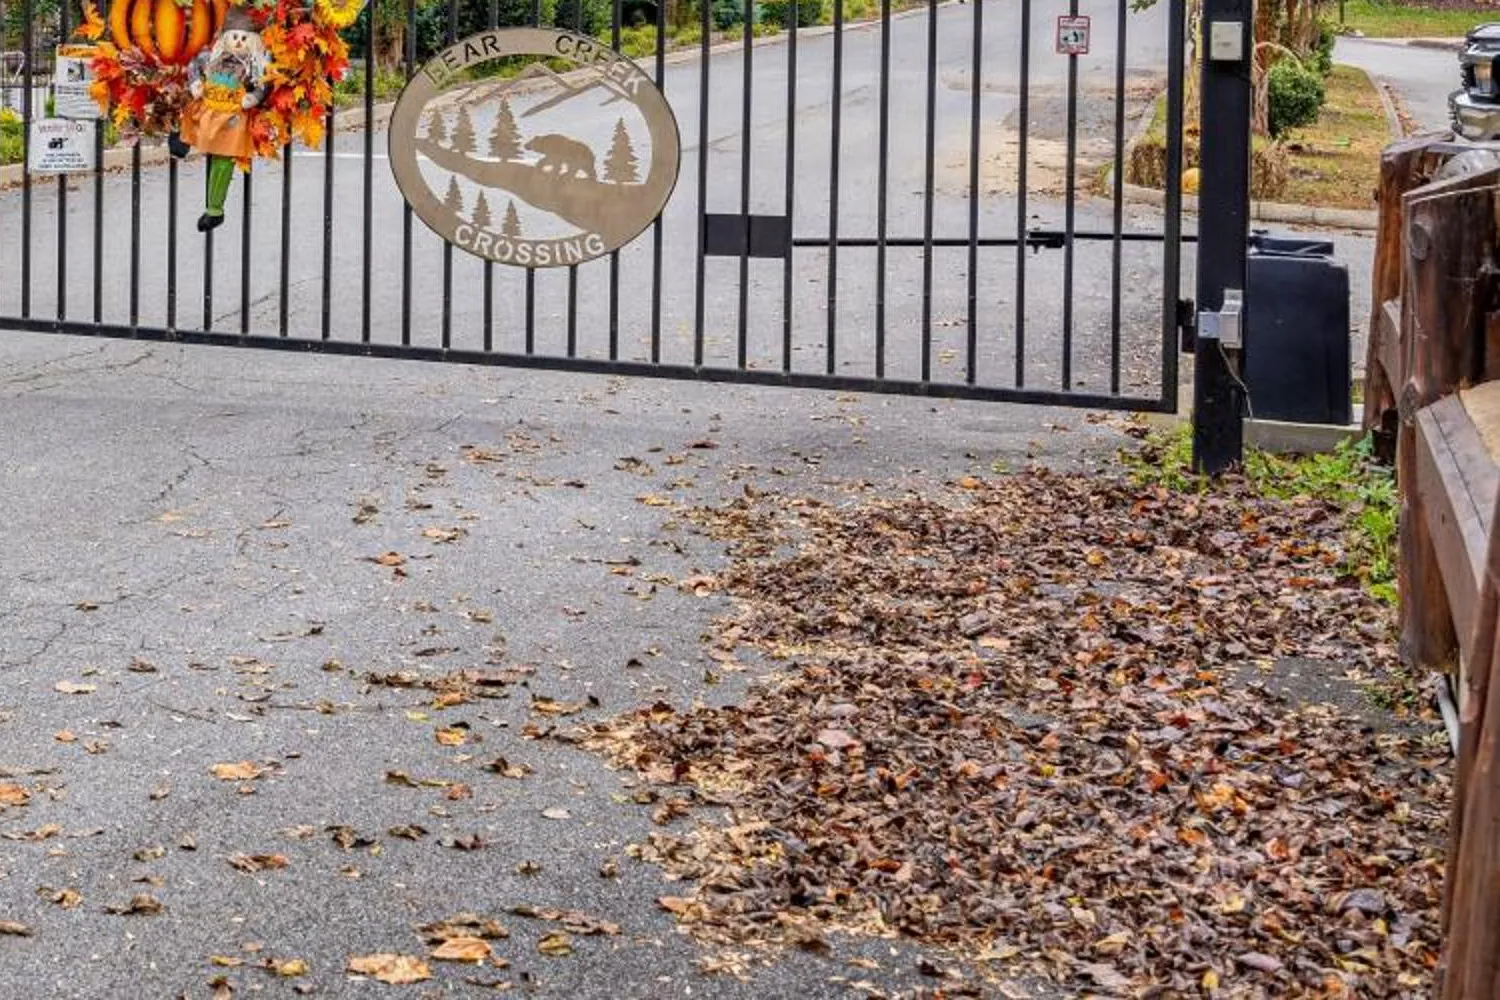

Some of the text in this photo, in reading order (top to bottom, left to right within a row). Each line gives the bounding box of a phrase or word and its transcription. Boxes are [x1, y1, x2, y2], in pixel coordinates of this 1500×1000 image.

[423, 34, 647, 94] BEAR CREEK
[455, 224, 604, 265] CROSSING
